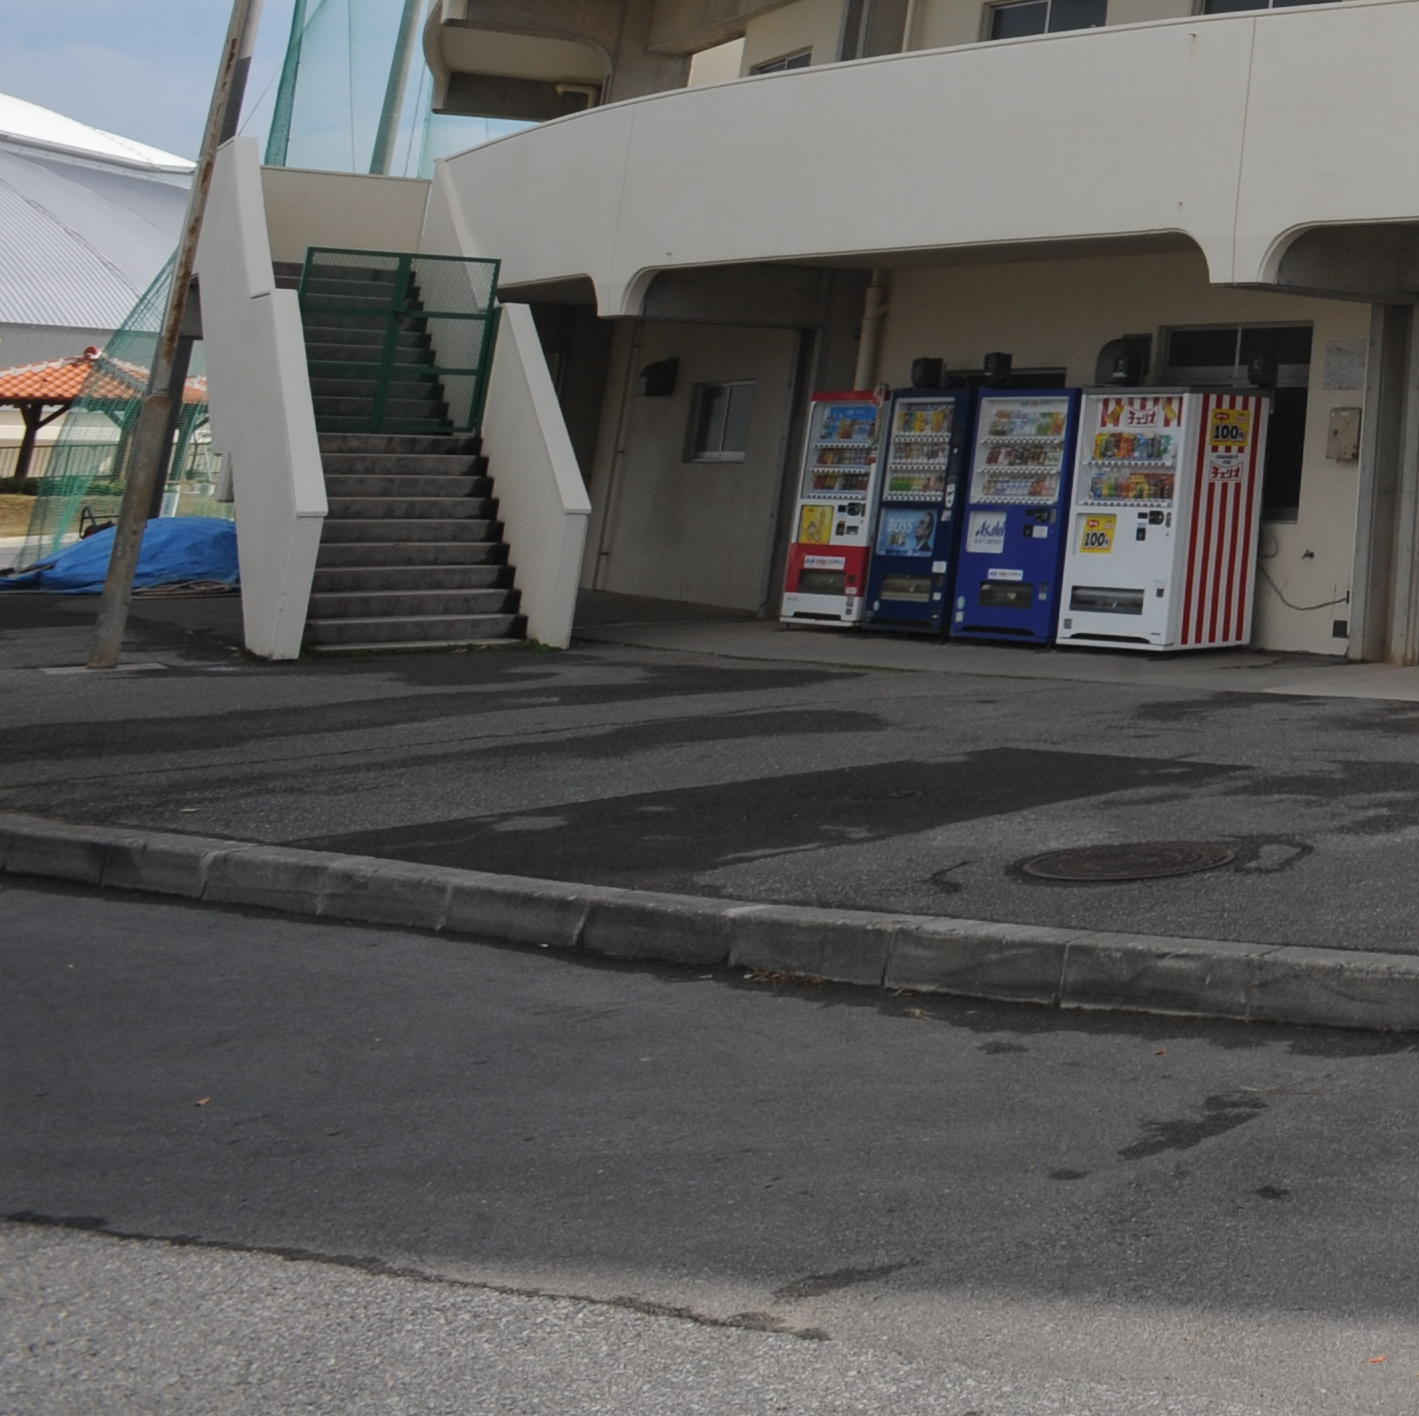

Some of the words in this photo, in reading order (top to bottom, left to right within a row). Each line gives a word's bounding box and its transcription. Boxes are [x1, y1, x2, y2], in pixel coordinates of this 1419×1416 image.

[1127, 410, 1156, 425] チェリオ
[1211, 466, 1240, 480] チェリオ
[887, 518, 914, 533] BOSS
[975, 520, 1007, 537] Asahi
